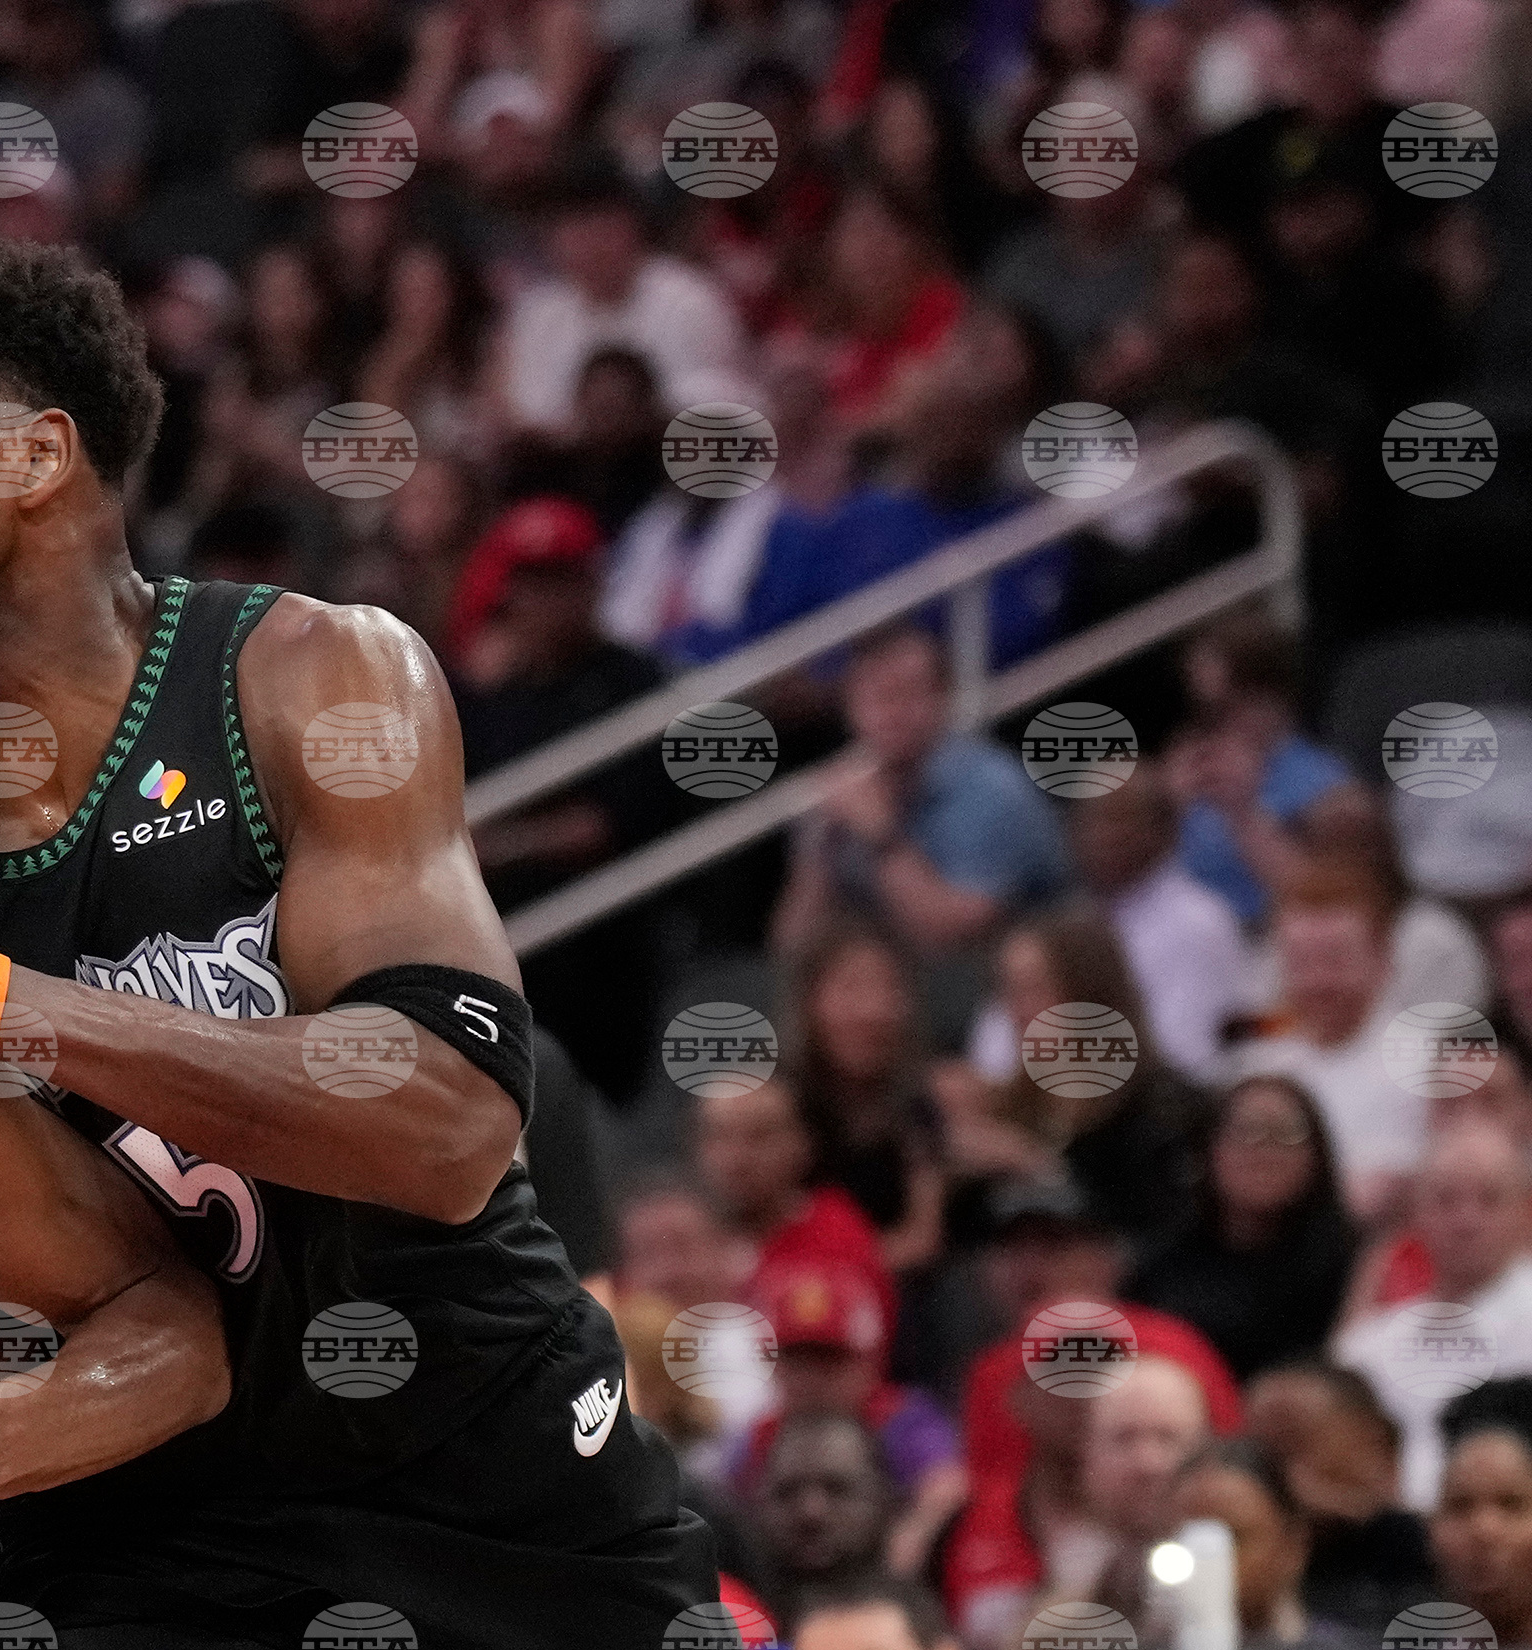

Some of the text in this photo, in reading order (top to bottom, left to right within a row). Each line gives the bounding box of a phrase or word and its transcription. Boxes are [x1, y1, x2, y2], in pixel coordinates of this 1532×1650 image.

[111, 798, 227, 853] sezzle
[453, 993, 499, 1044] 5
[571, 1378, 611, 1434] NIKE
